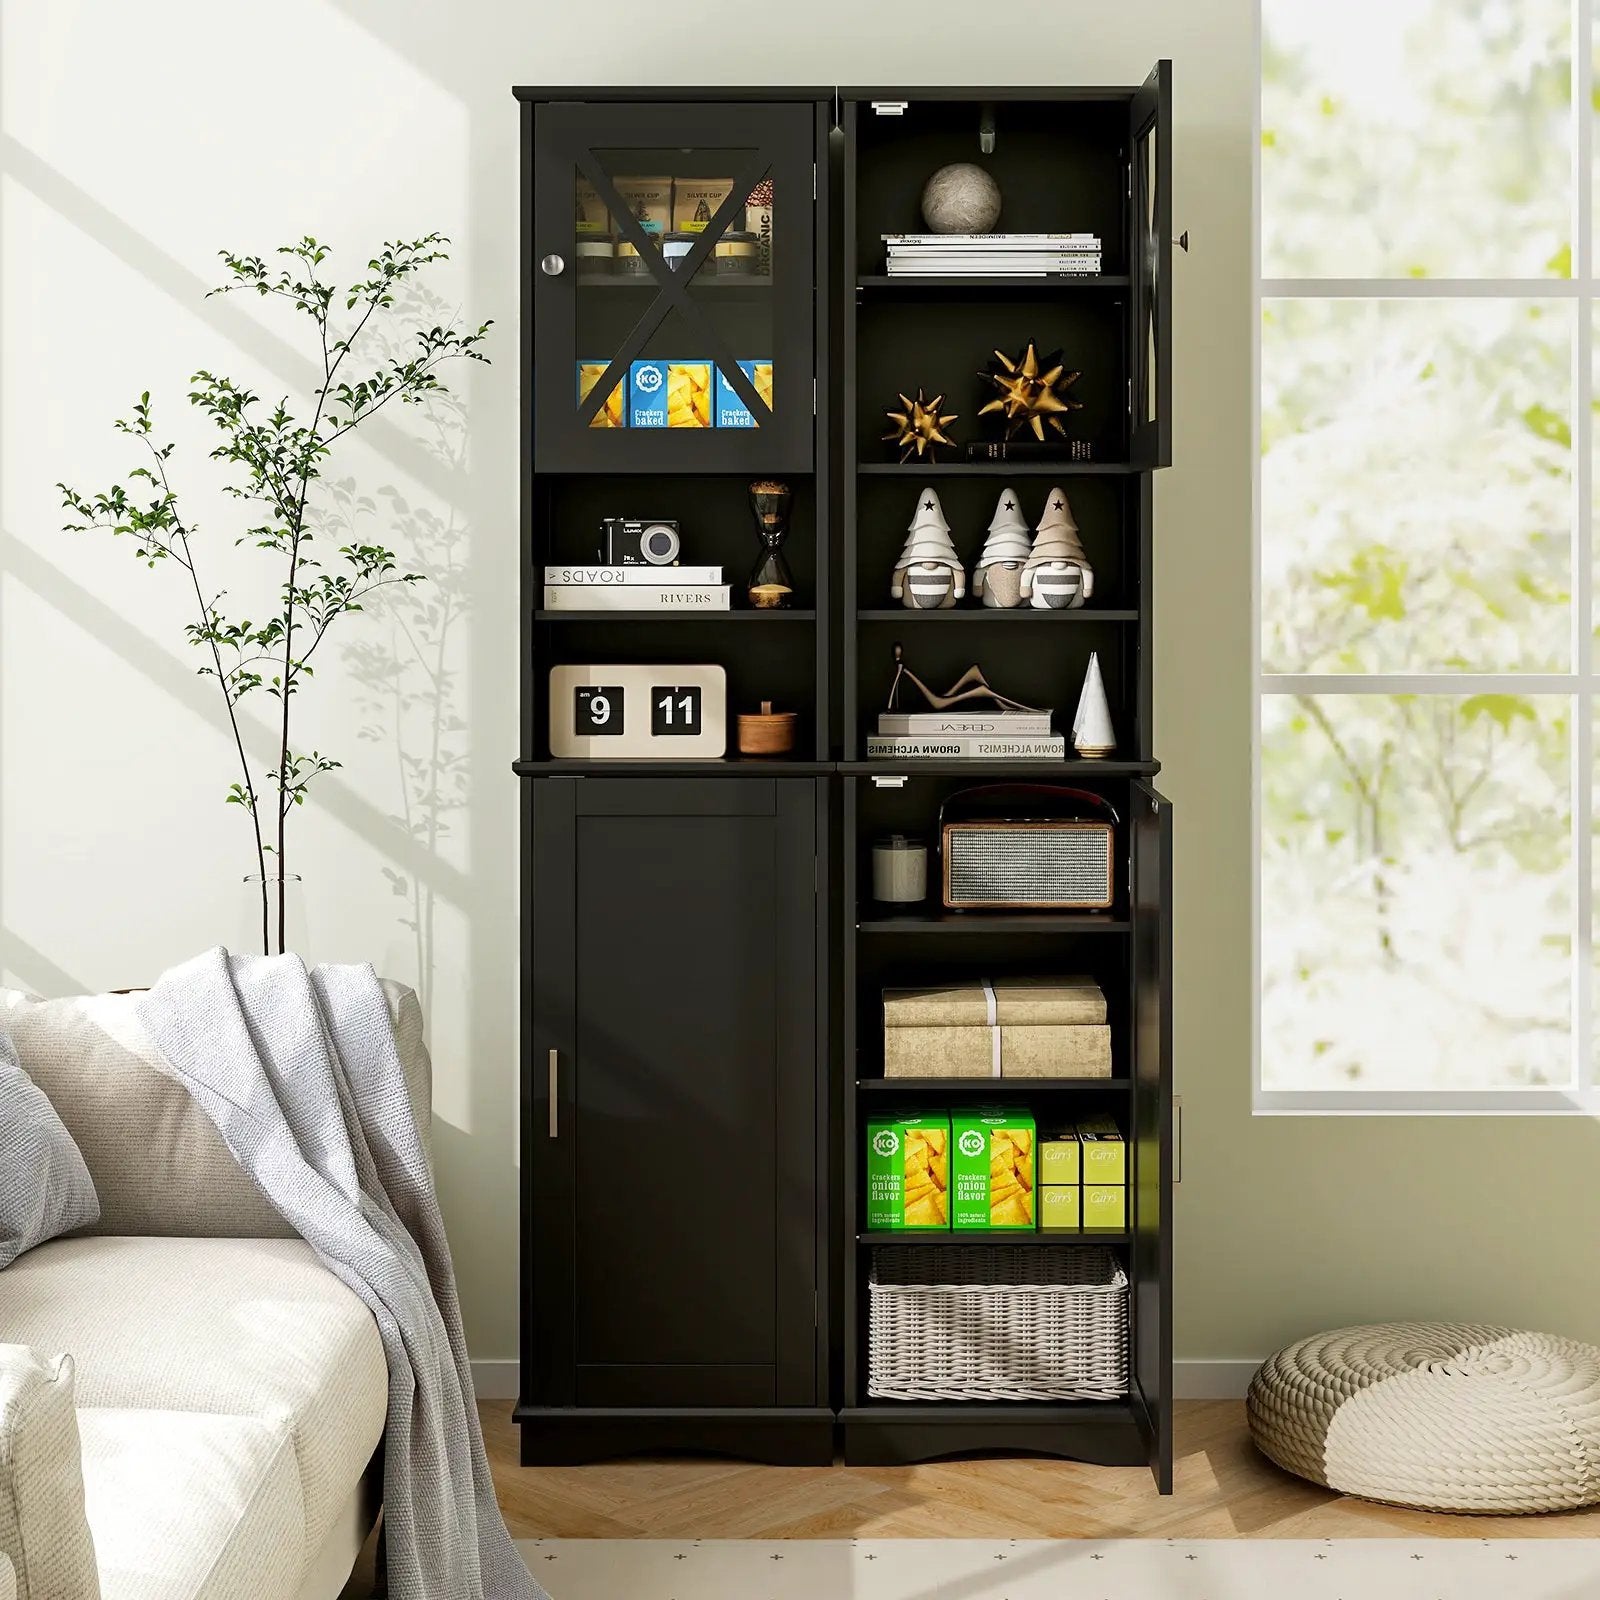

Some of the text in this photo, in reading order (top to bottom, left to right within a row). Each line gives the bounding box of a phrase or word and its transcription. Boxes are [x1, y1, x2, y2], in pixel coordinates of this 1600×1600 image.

[760, 214, 770, 276] ORGANIC
[635, 415, 664, 425] baked
[721, 415, 750, 425] baked
[562, 570, 625, 583] ROADS
[660, 594, 711, 603] RIVERS
[590, 696, 693, 725] 9 11
[878, 1138, 895, 1148] KO
[963, 1138, 980, 1148] KO
[872, 1181, 900, 1190] onion
[958, 1181, 986, 1190] onion
[872, 1190, 899, 1200] flavor
[958, 1190, 985, 1200] flavor
